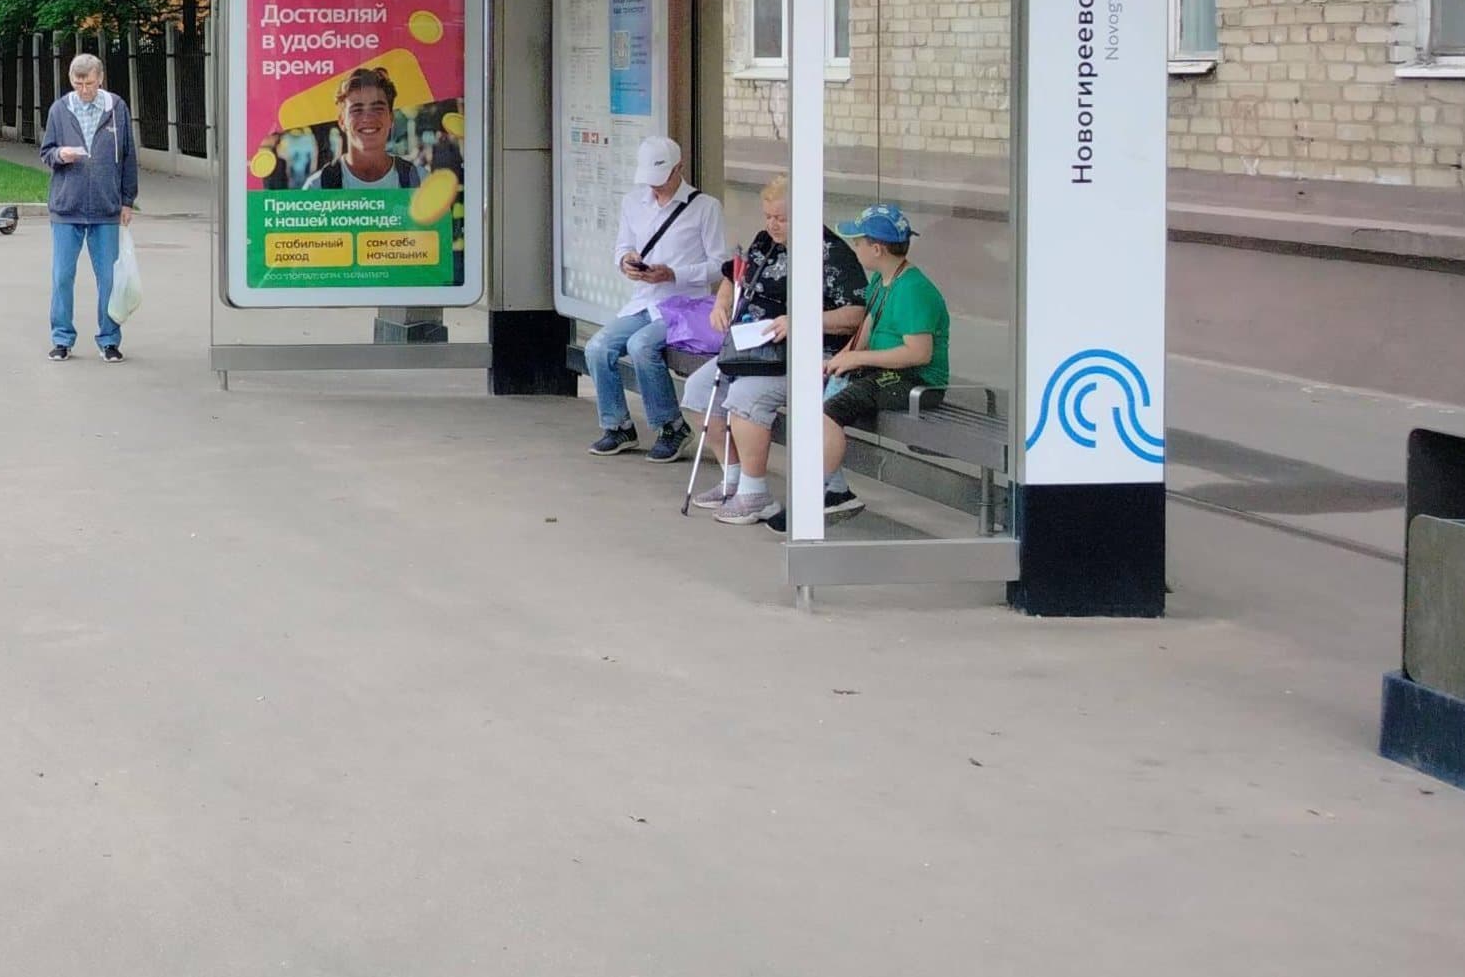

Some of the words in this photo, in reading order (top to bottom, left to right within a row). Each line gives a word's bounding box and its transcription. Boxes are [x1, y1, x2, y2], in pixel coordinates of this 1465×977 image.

[261, 2, 387, 28] Доставляй
[262, 34, 275, 49] в
[280, 30, 379, 54] удобное
[262, 59, 334, 80] время
[264, 197, 385, 214] Присоединяйся
[264, 217, 273, 227] к
[276, 213, 328, 227] нашей
[331, 214, 402, 228] команде:
[275, 237, 344, 249] стабильный
[366, 238, 388, 248] сам
[391, 236, 416, 247] себе
[274, 253, 310, 262] доход
[366, 250, 428, 260] начальник
